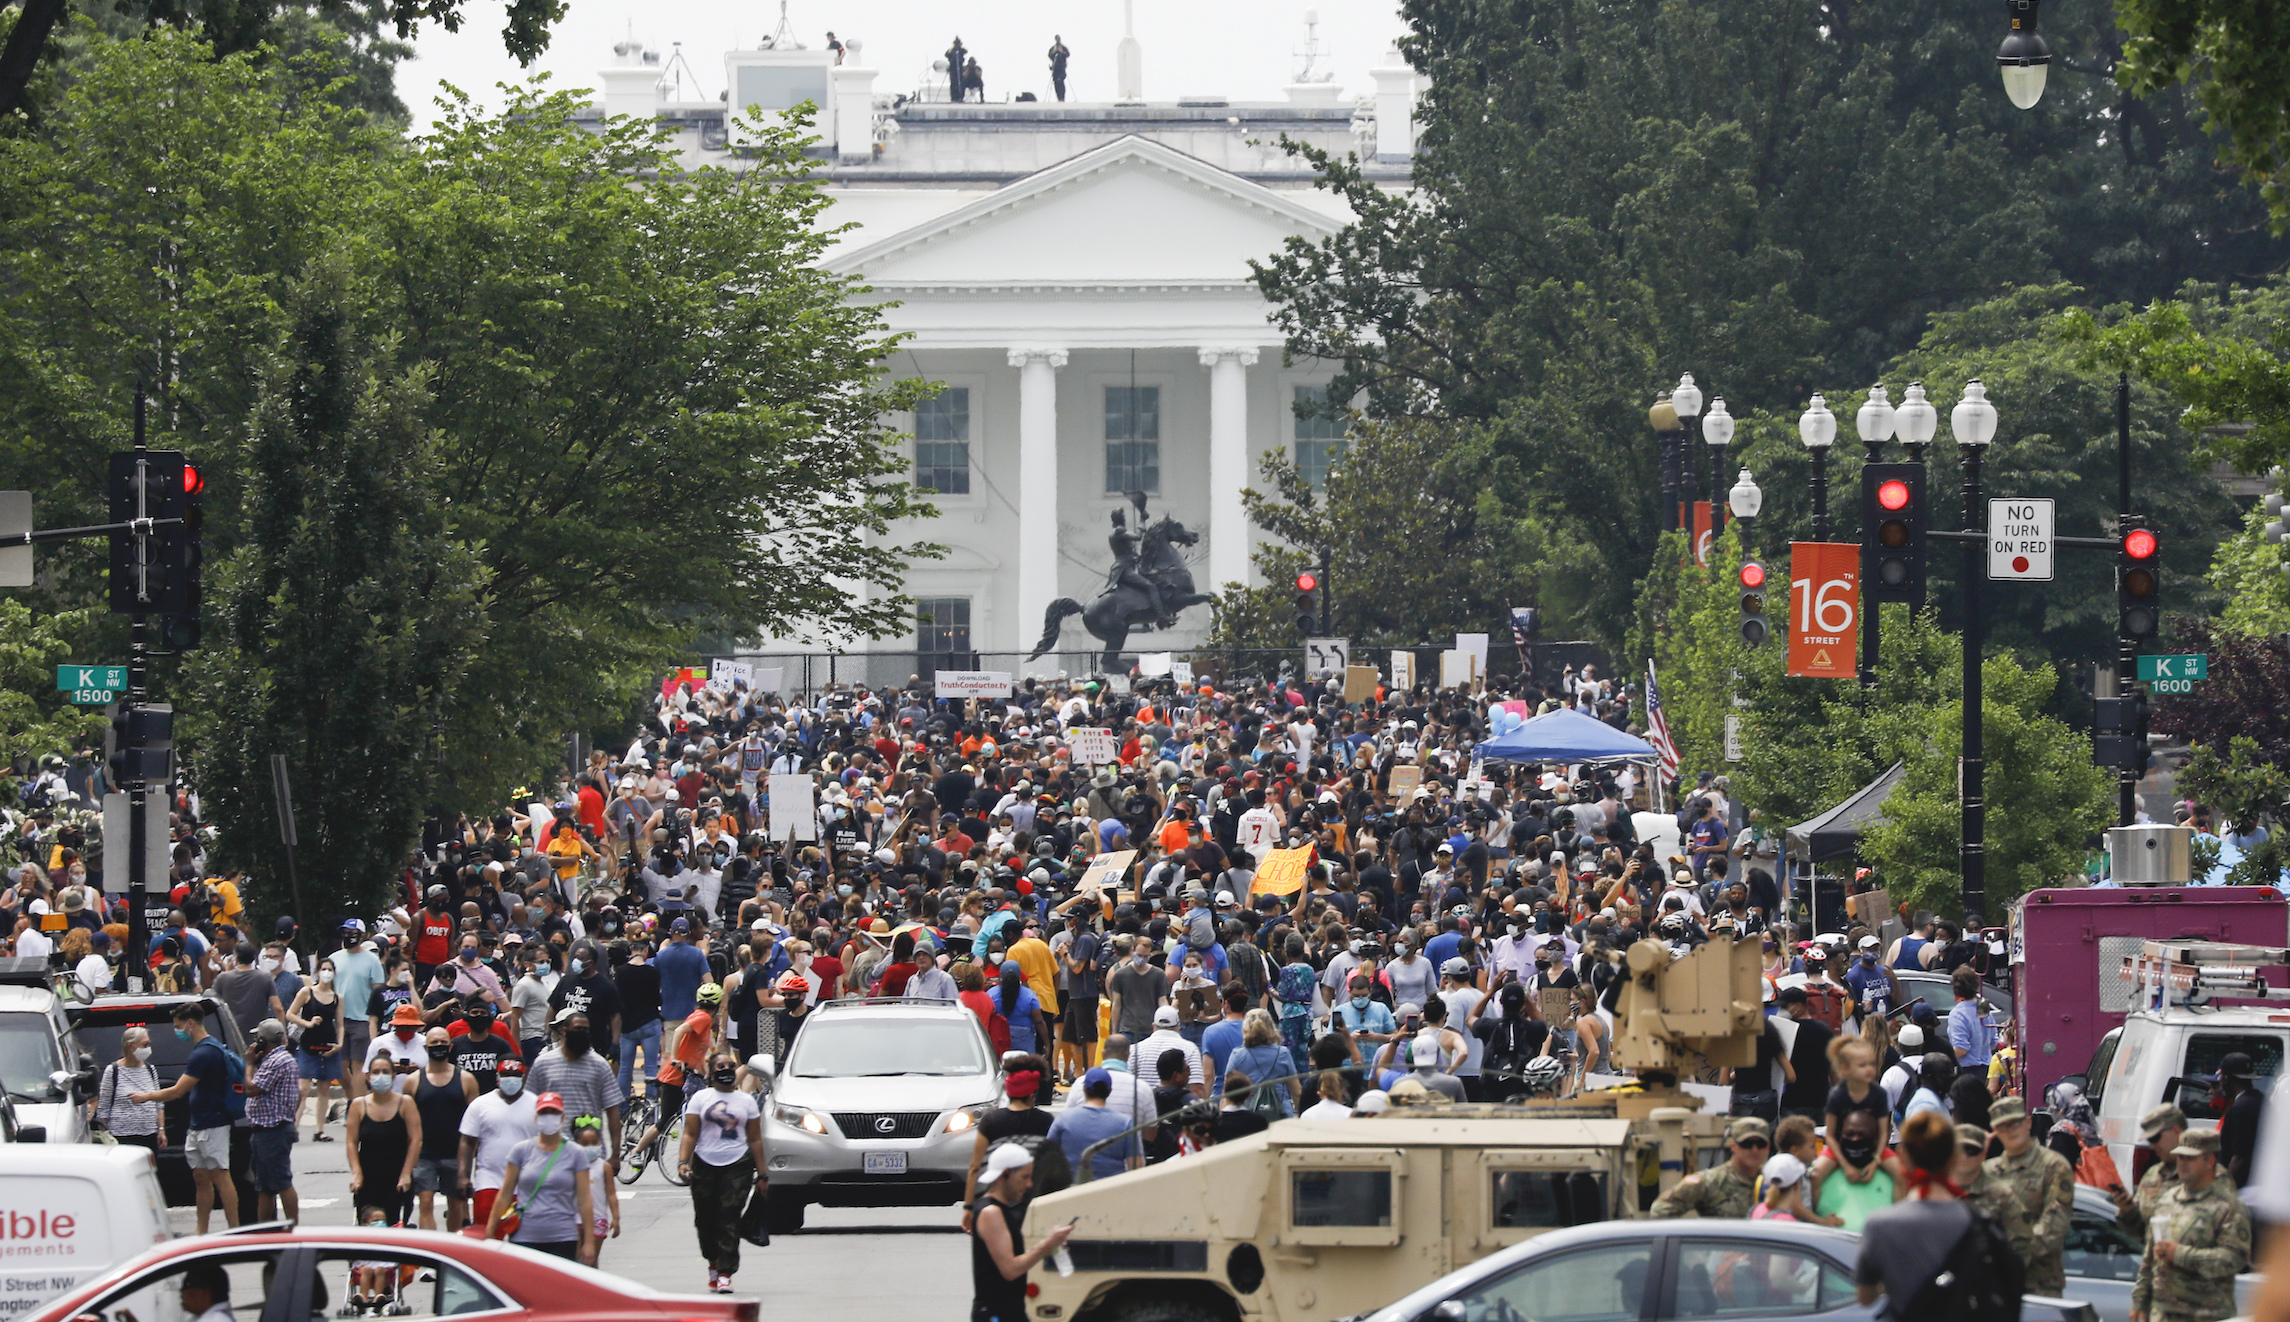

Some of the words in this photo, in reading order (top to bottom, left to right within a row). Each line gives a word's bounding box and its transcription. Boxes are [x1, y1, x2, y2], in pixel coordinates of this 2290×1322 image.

[2008, 506, 2034, 520] NO
[2004, 524, 2039, 536] TURN
[1995, 541, 2013, 553] ON
[2021, 541, 2047, 553] RED
[1792, 578, 1853, 633] 16
[1804, 636, 1840, 644] STREET
[2156, 658, 2173, 676] K
[2186, 659, 2198, 667] ST
[2185, 667, 2198, 675] NW
[79, 669, 95, 687] K
[108, 670, 120, 678] ST
[2152, 680, 2191, 692] 1600
[74, 690, 112, 702] 1500
[1253, 825, 1261, 844] 7
[426, 926, 449, 936] OBEY
[575, 986, 587, 995] The
[1546, 991, 1569, 1005] ENOUG
[457, 1060, 498, 1071] SATAN
[6, 1278, 47, 1291] Street
[51, 1277, 75, 1289] NW
